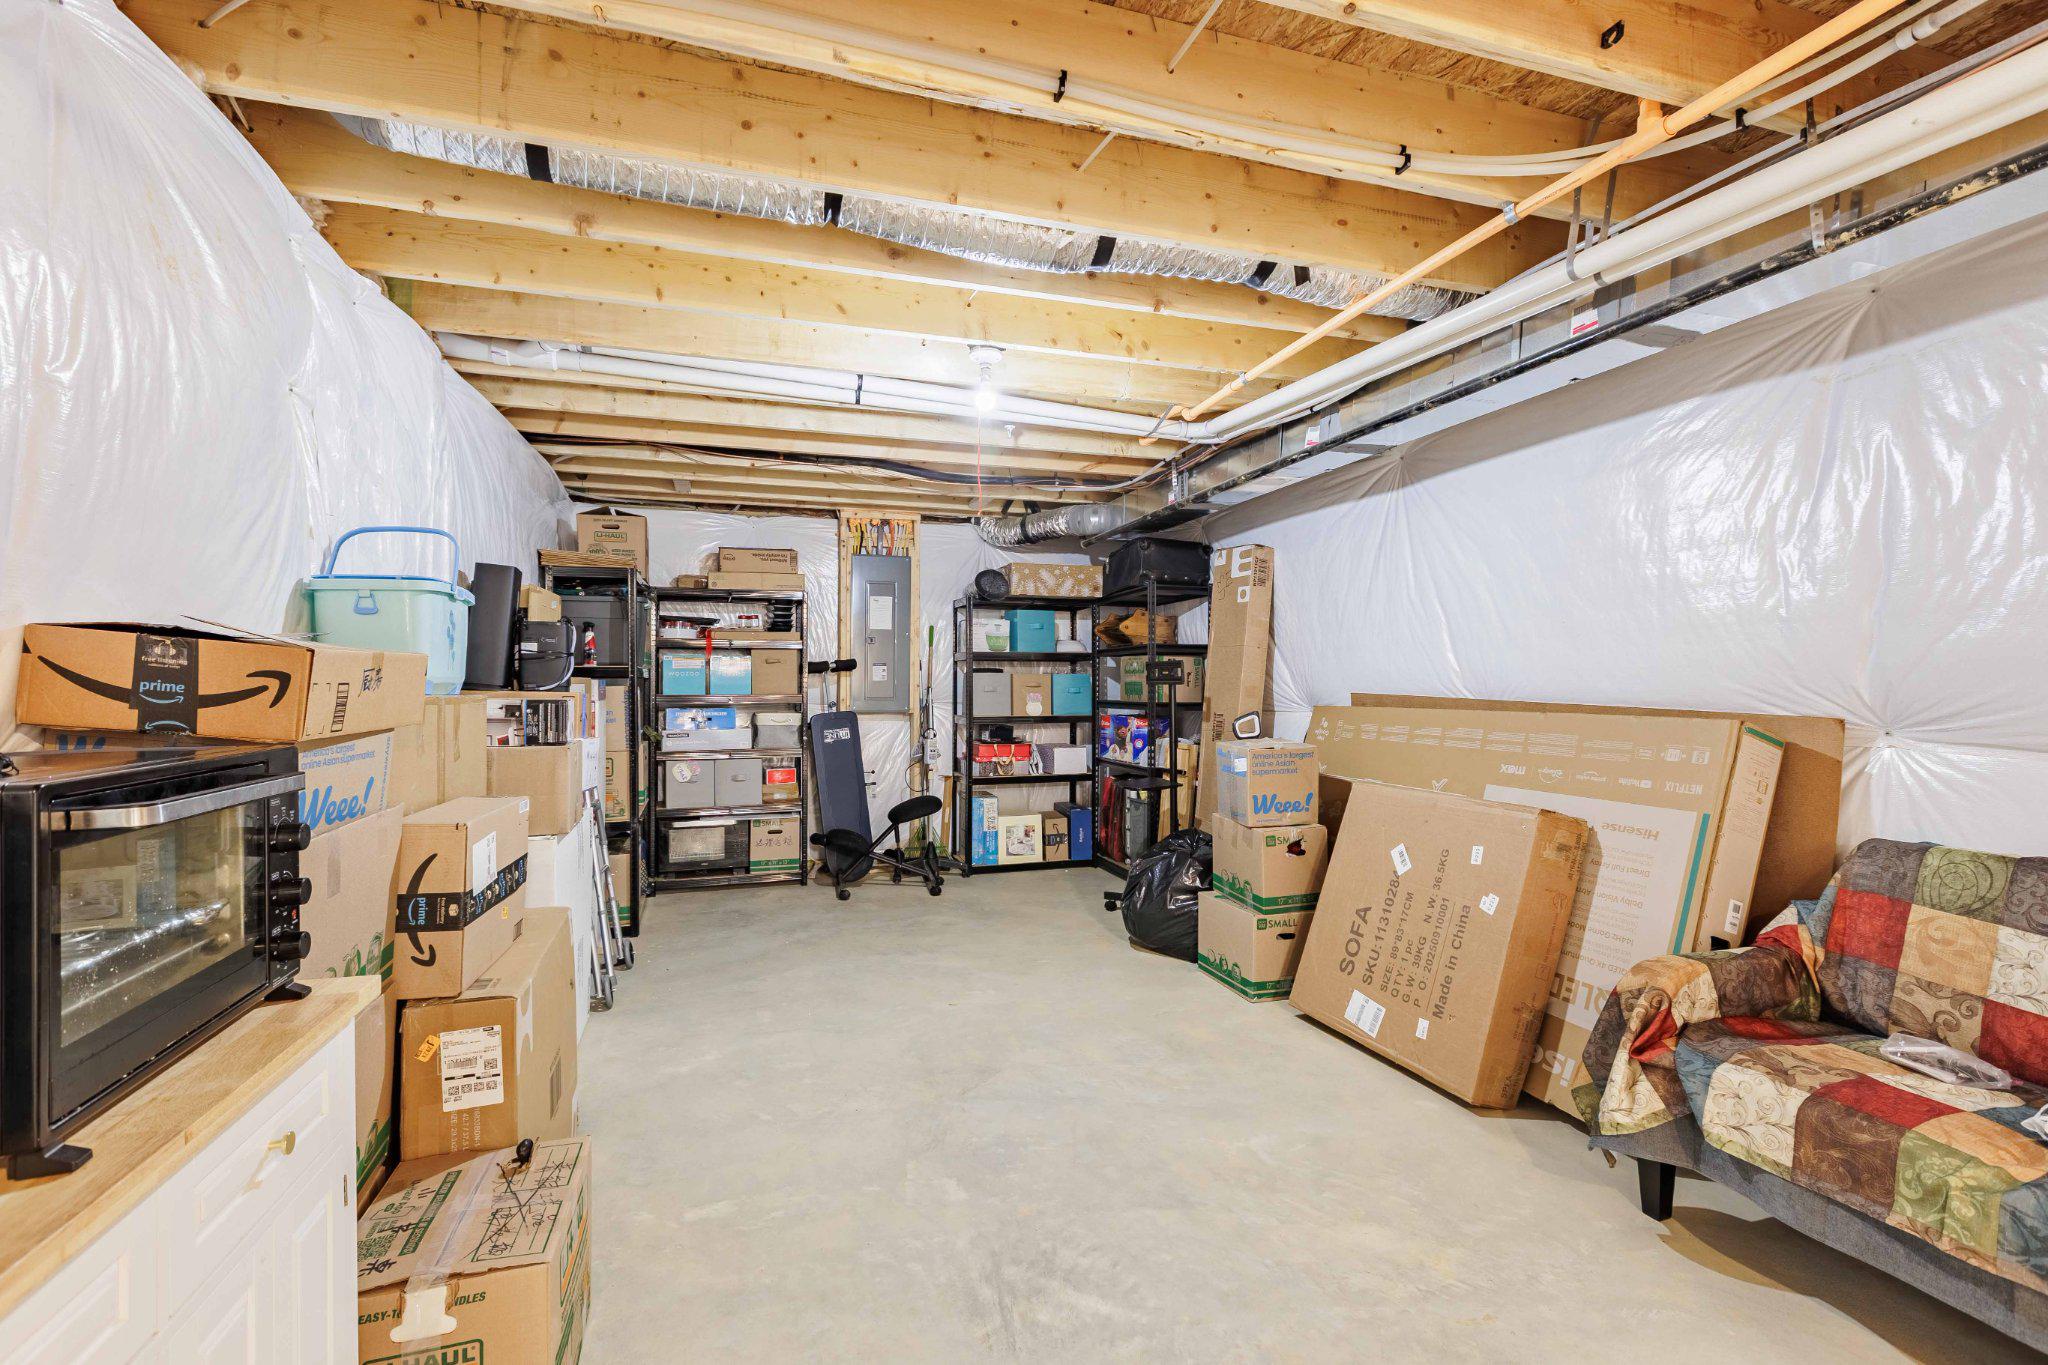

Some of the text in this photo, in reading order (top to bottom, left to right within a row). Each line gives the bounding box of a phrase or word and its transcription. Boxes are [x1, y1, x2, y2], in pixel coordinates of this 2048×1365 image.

[140, 679, 185, 693] prime
[301, 760, 322, 771] online
[1275, 759, 1296, 767] Asian
[1252, 767, 1298, 776] supermarket
[1664, 779, 1704, 795] NETFLIX
[298, 775, 375, 830] Weee!
[1252, 791, 1314, 815] Weee!
[1601, 821, 1659, 841] Hisense
[1588, 858, 1650, 878] Direct Full Array
[1596, 892, 1619, 904] Vision
[1620, 894, 1643, 910] Dolby
[417, 897, 426, 925] prime
[1412, 935, 1428, 968] 39KG
[1432, 848, 1450, 890] 36.5KG
[1268, 918, 1298, 928] SMALL
[1338, 907, 1372, 975] SOFA
[1588, 926, 1611, 940] Game
[1612, 933, 1634, 946] 144Hz
[1432, 904, 1471, 1019] Made in China
[1380, 962, 1396, 992] SIZE:
[1390, 965, 1406, 997] QTY:
[453, 1291, 487, 1307] NDLES
